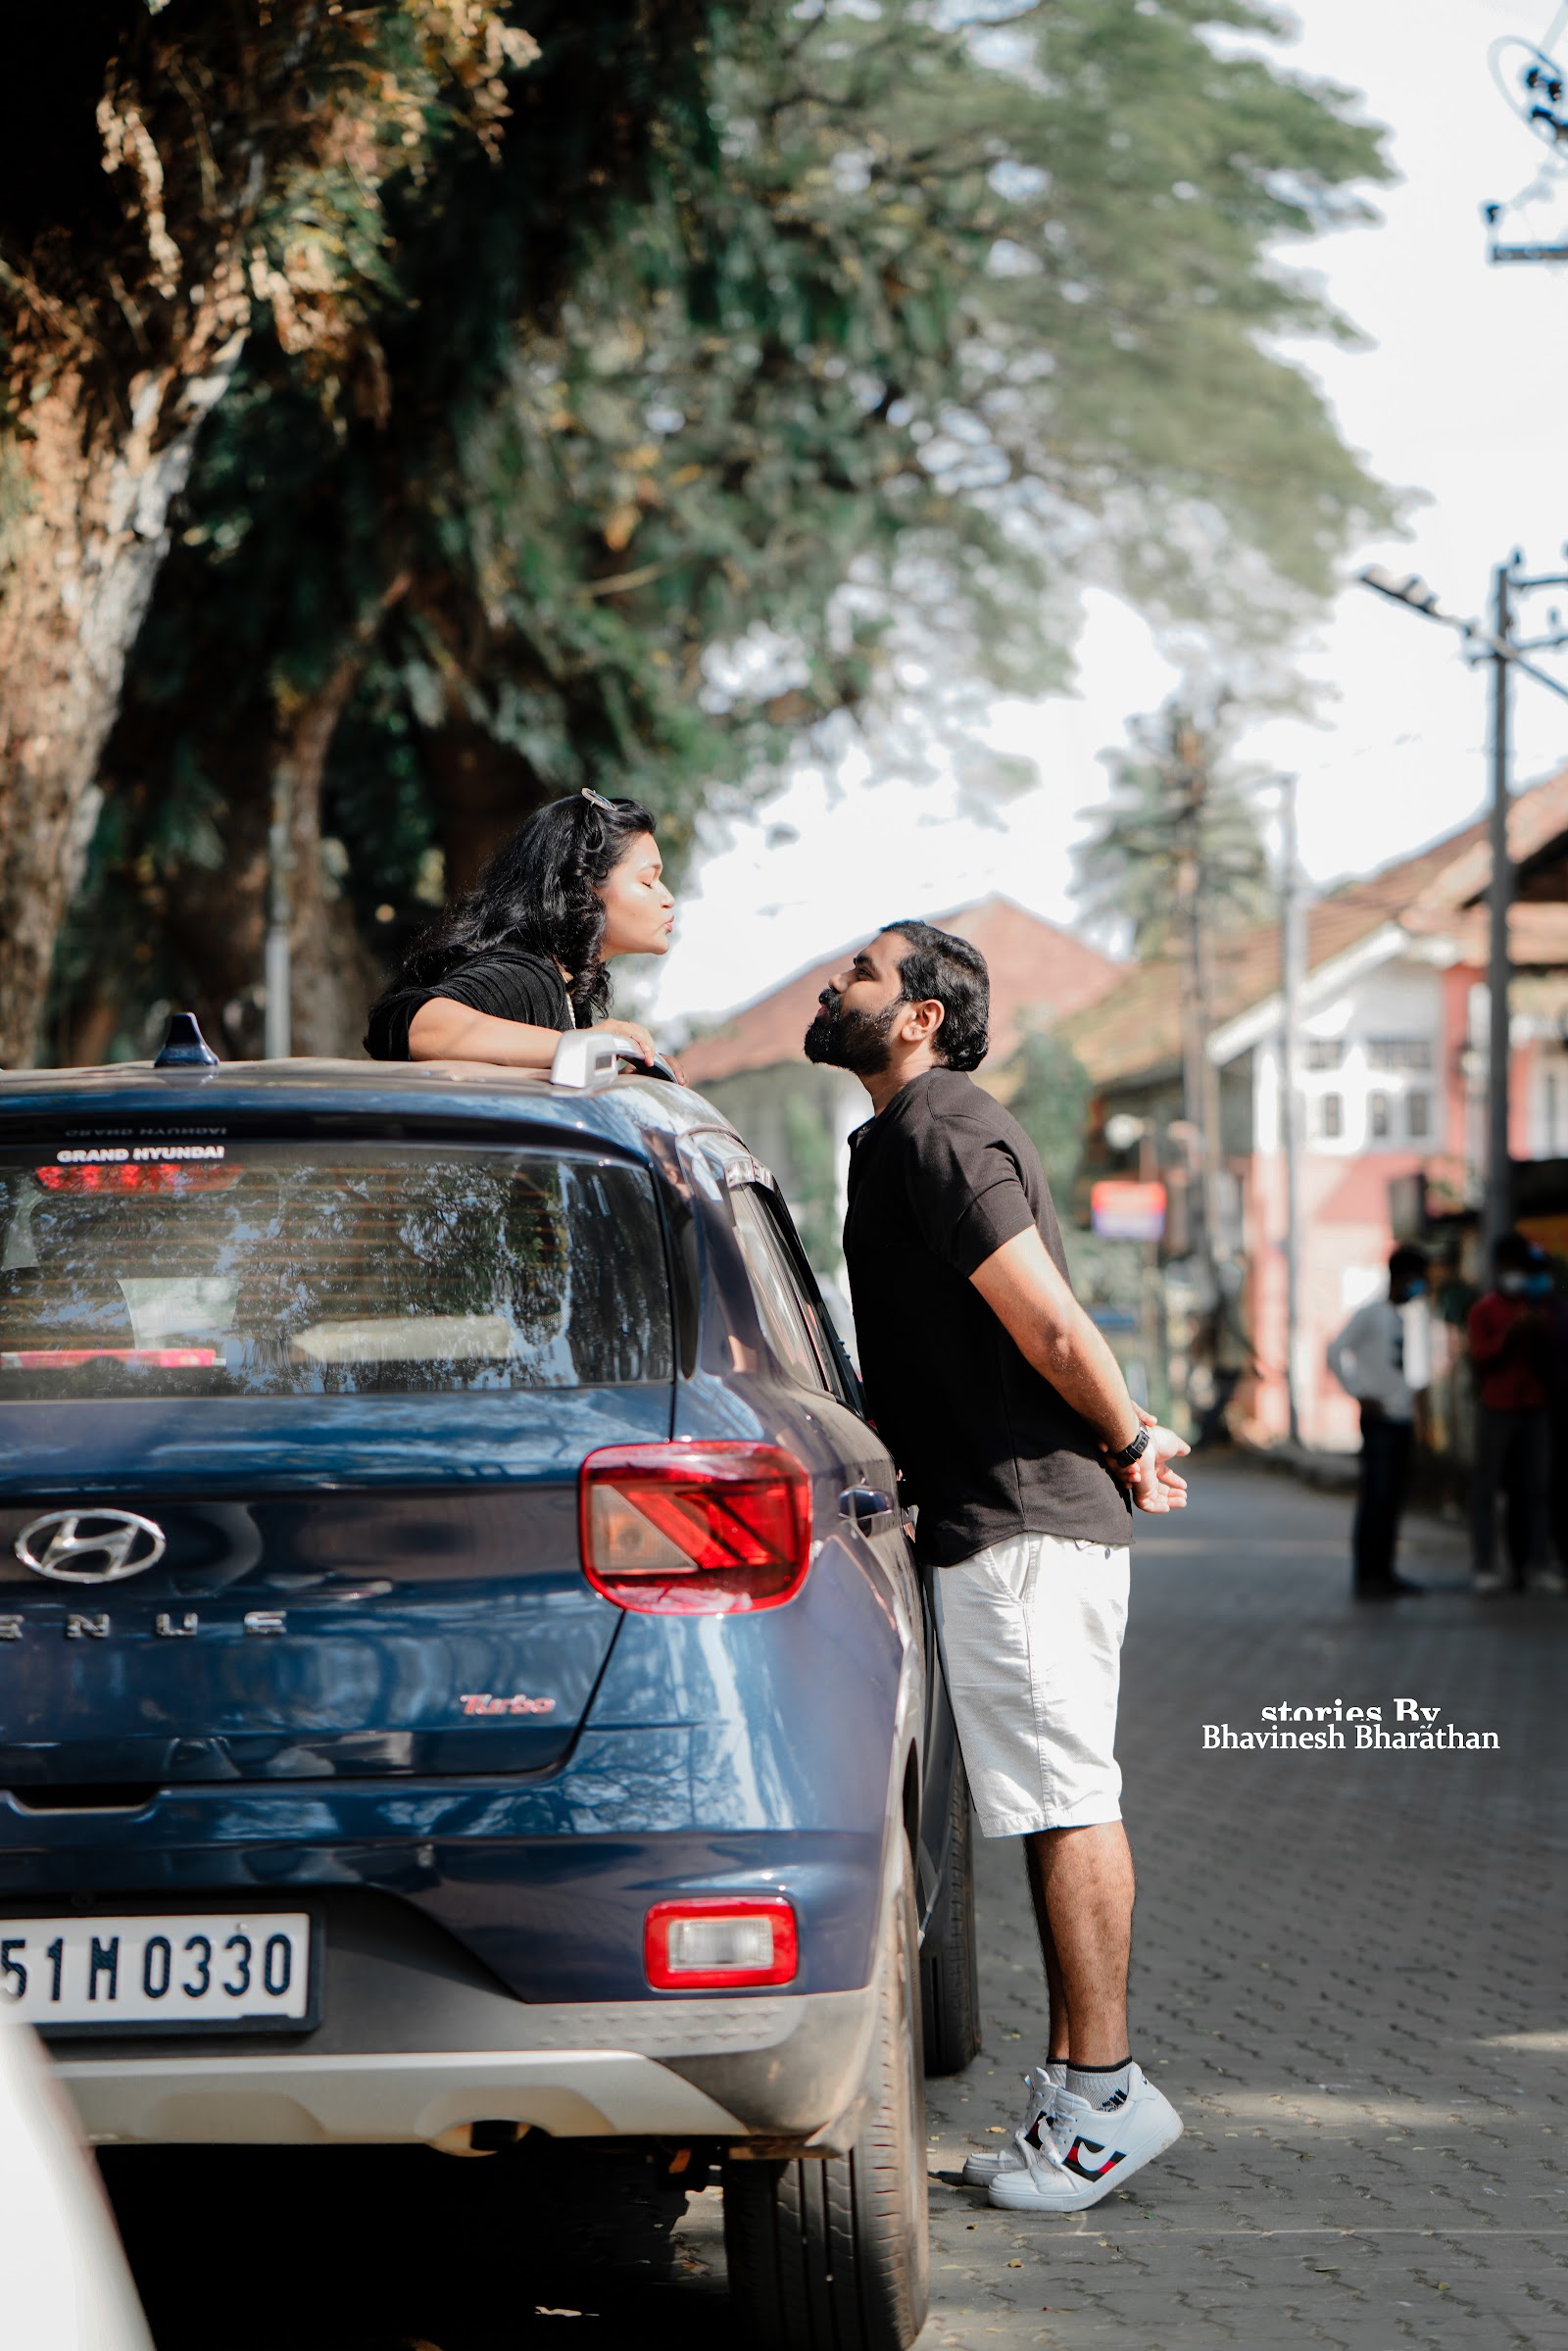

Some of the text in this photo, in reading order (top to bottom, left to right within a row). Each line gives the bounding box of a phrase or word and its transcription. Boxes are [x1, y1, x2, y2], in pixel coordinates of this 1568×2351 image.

[57, 1146, 225, 1163] GRAND HYUNDAI
[460, 1693, 557, 1716] Turbo
[143, 1934, 292, 1999] 0330
